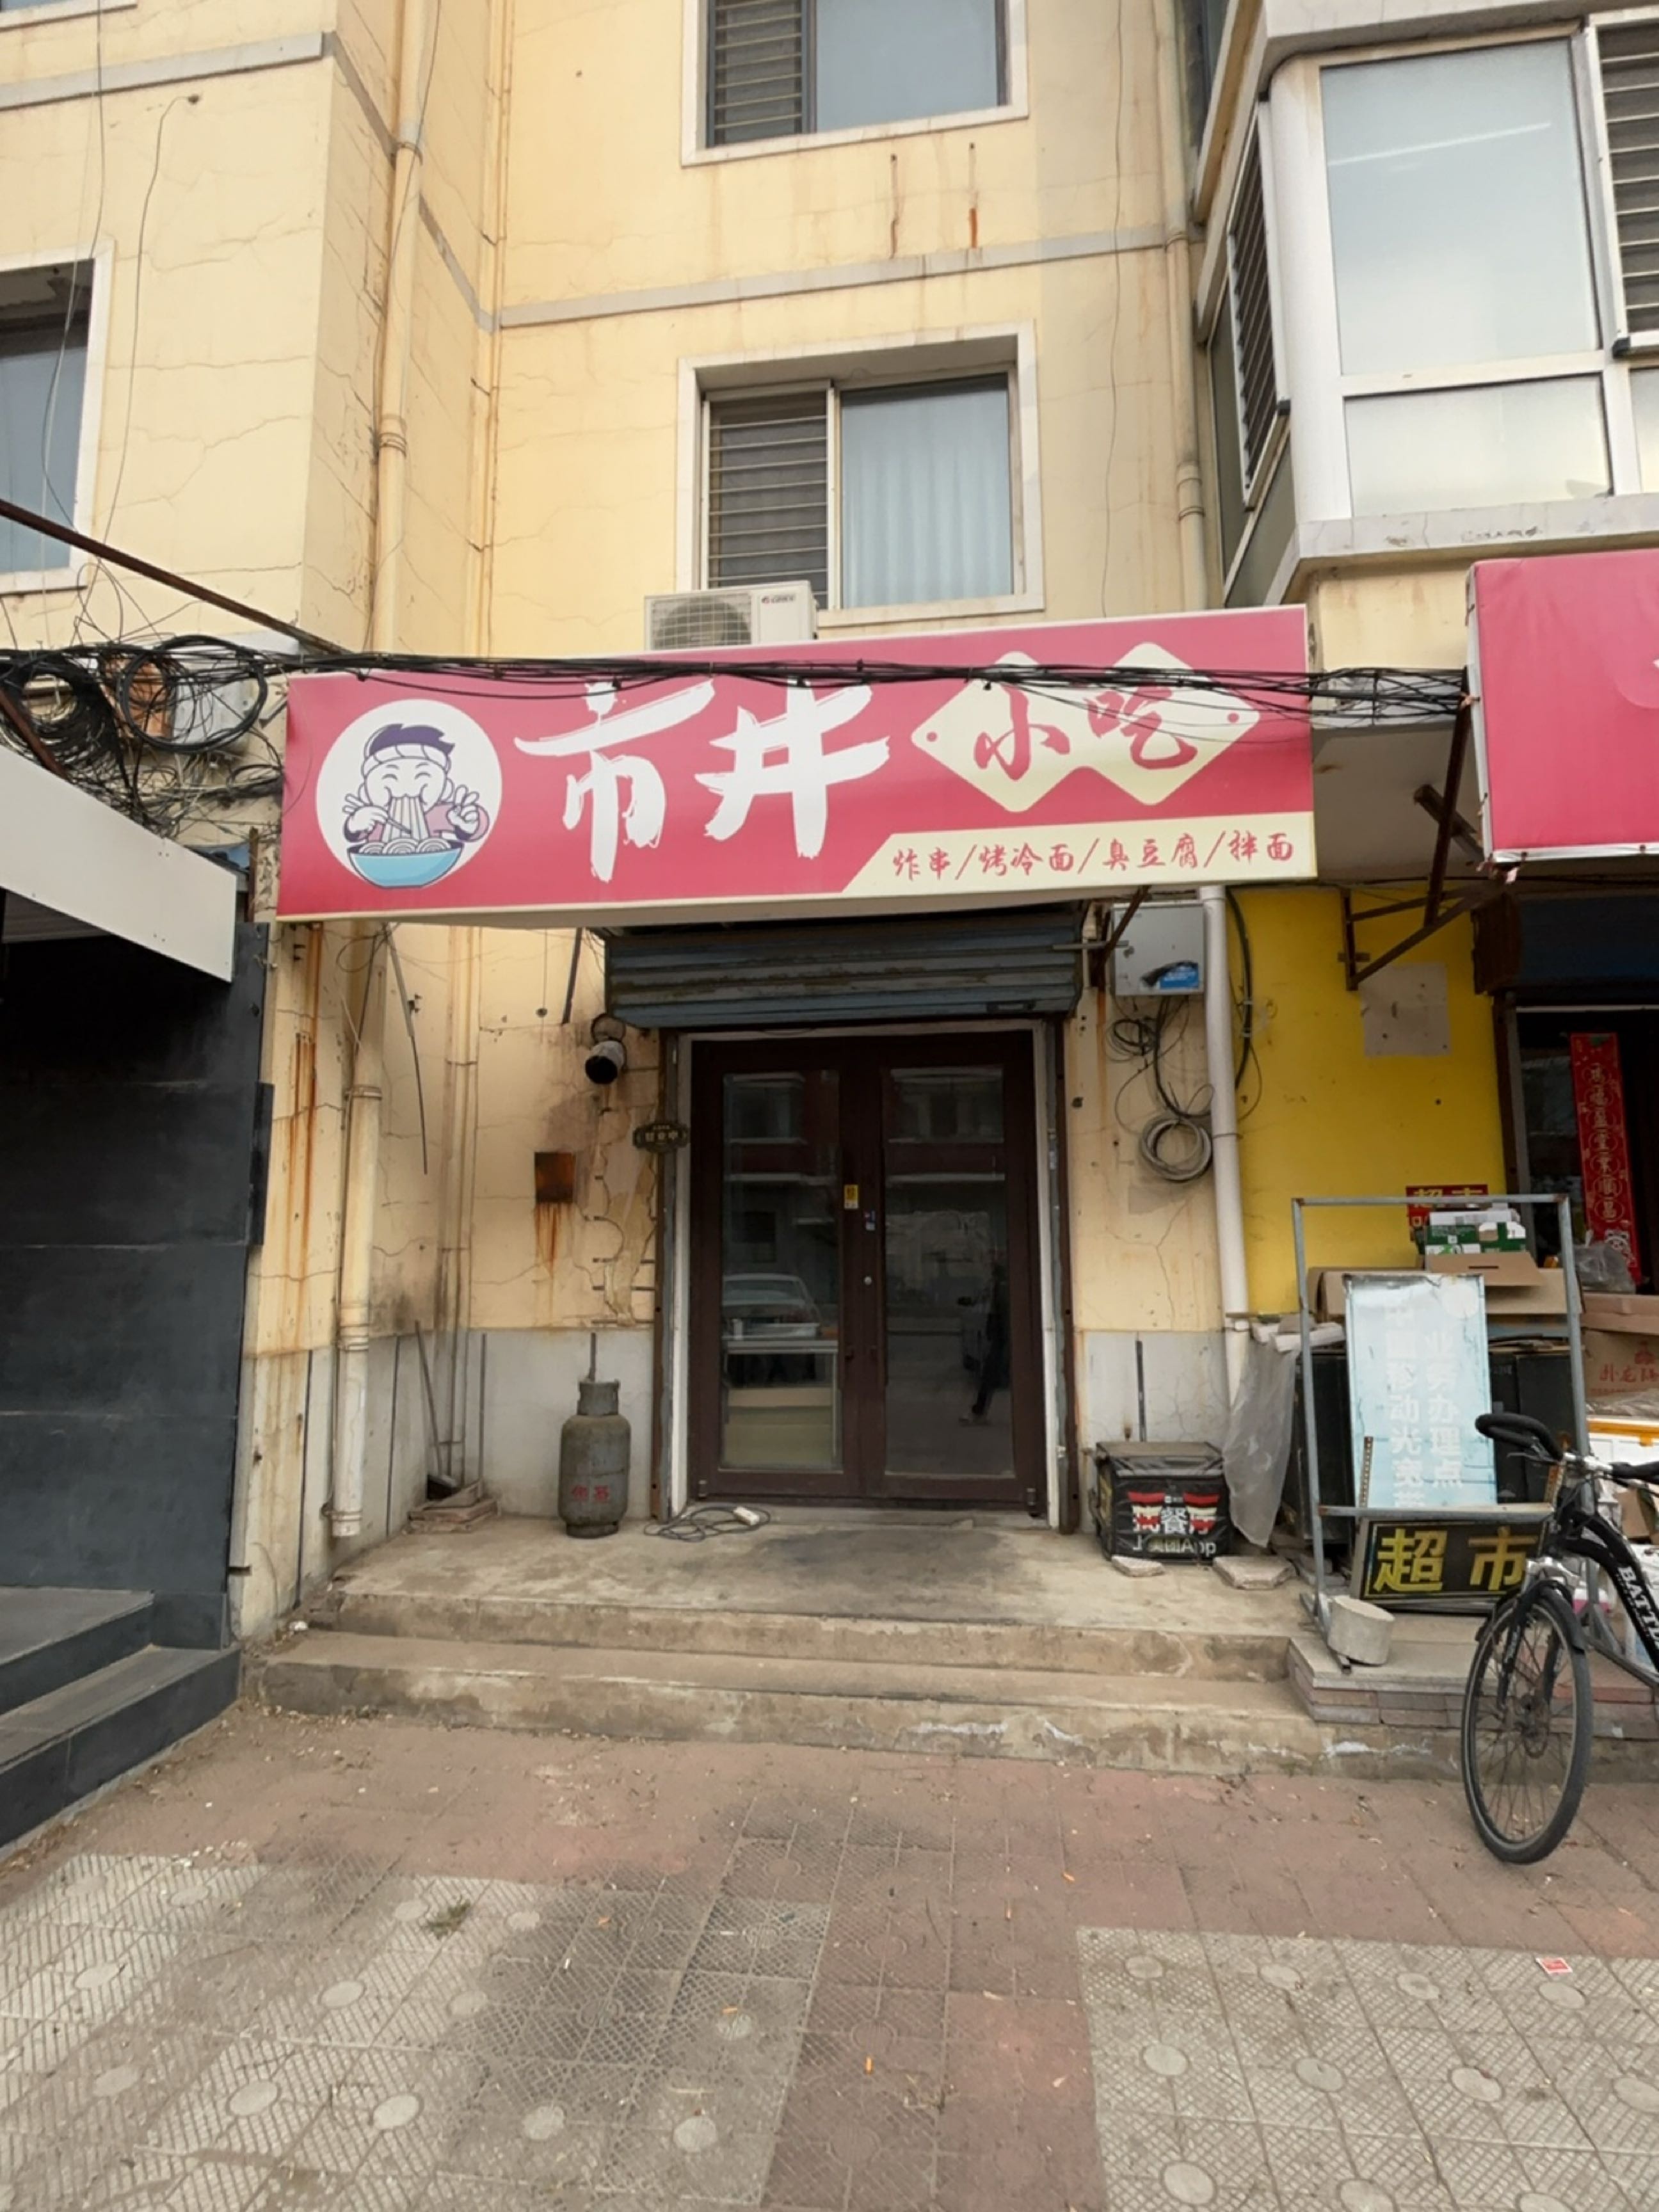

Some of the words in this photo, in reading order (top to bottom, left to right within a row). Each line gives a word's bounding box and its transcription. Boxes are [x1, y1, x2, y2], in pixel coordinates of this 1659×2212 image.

[514, 678, 891, 882] 市井
[975, 677, 1198, 781] 小吃
[1373, 1526, 1528, 1592] 超市
